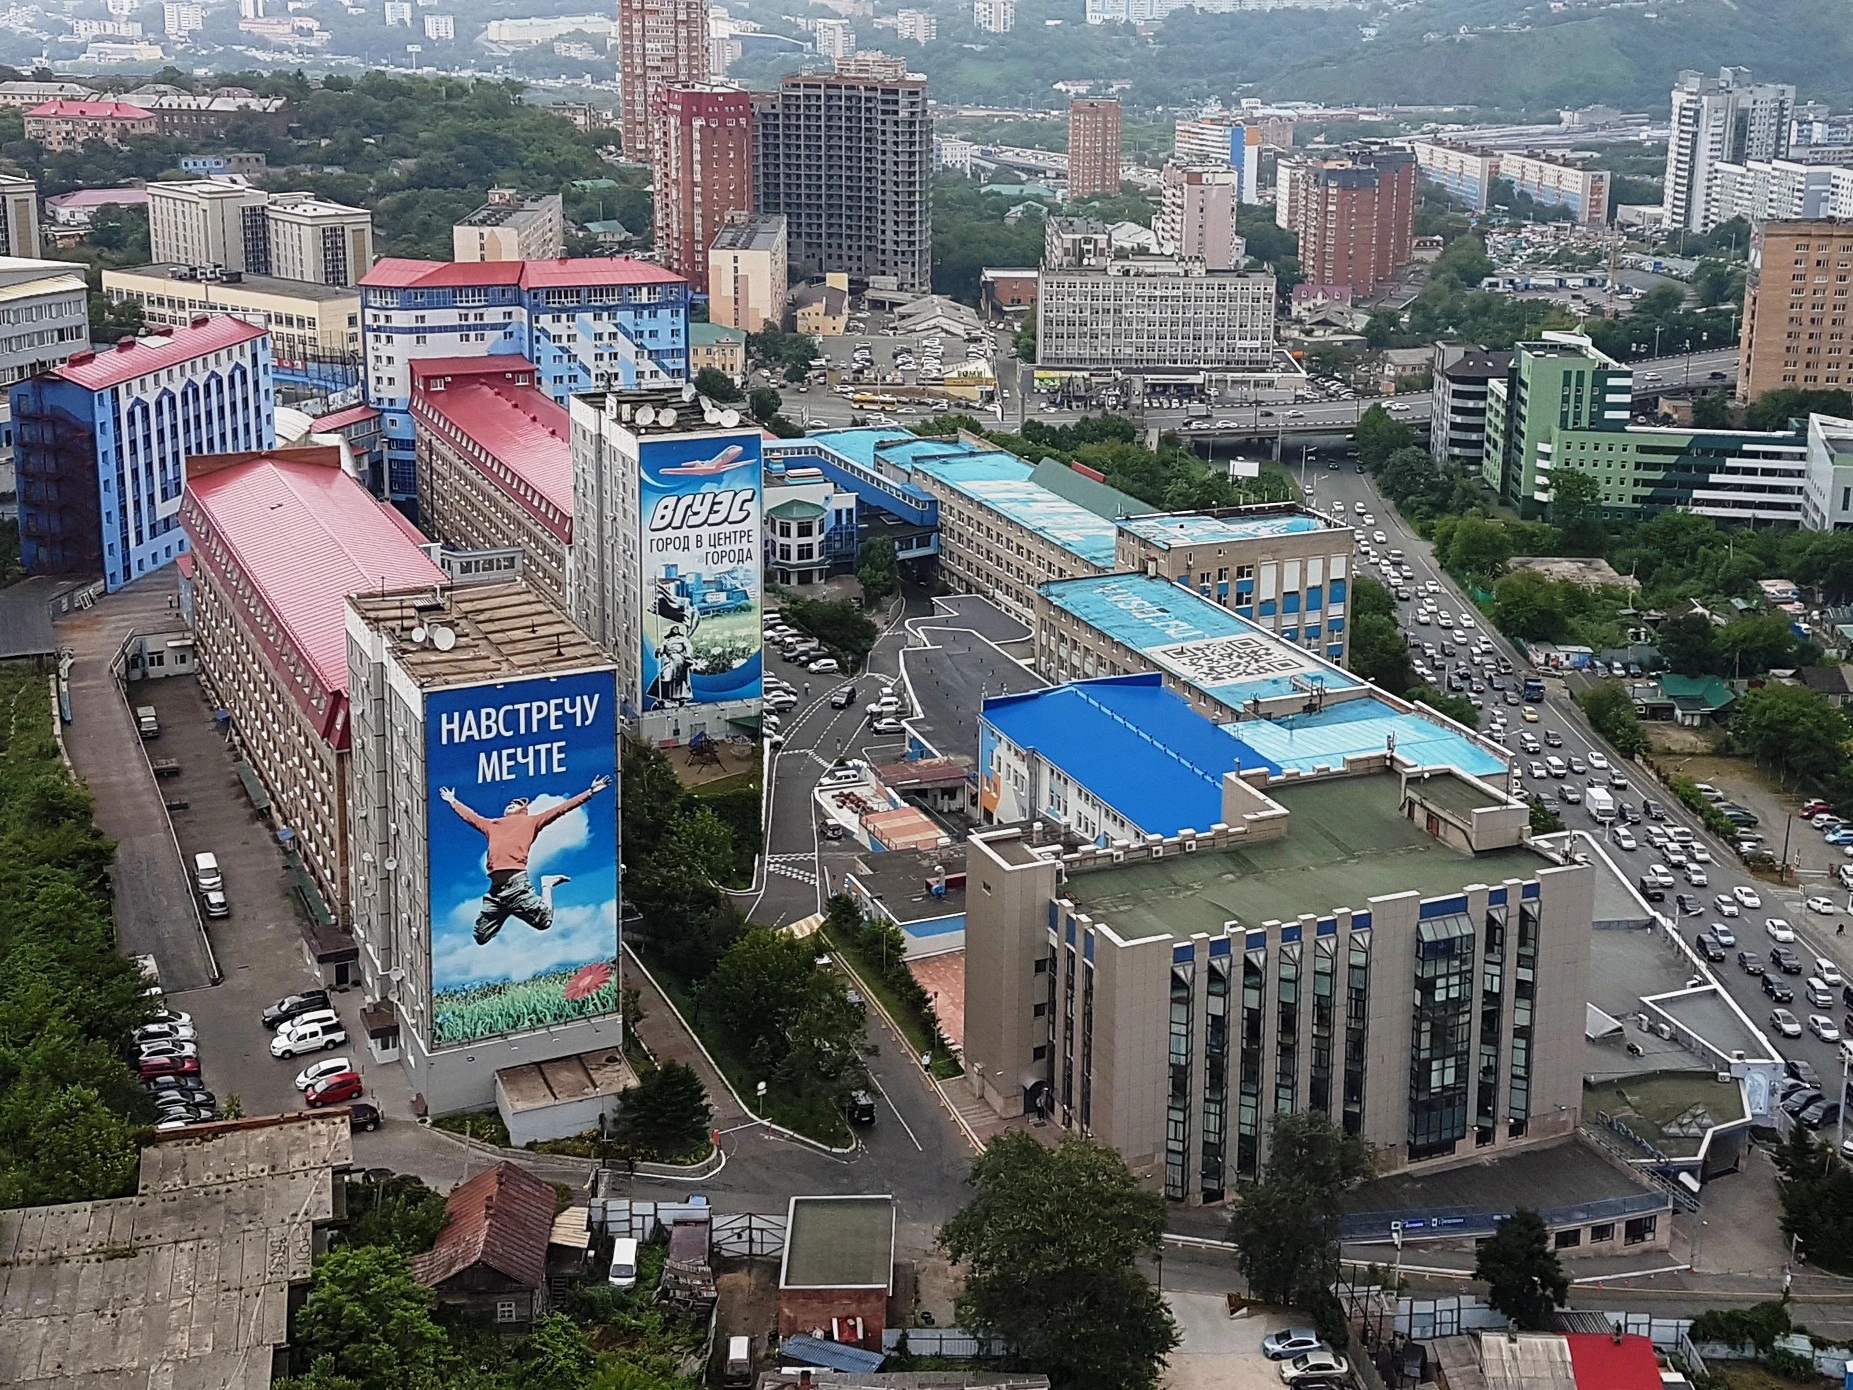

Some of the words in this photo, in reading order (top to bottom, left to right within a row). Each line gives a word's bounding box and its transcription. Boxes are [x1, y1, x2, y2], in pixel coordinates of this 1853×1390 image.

[649, 488, 756, 531] ВГУЭС
[650, 535, 690, 552] ГОРОД
[696, 534, 703, 548] В
[708, 529, 753, 549] ЦЕНТРЕ
[705, 547, 753, 565] ГОРОДА
[441, 693, 600, 744] НАВСТРЕЧУ
[477, 741, 567, 784] МЕЧТЕ
